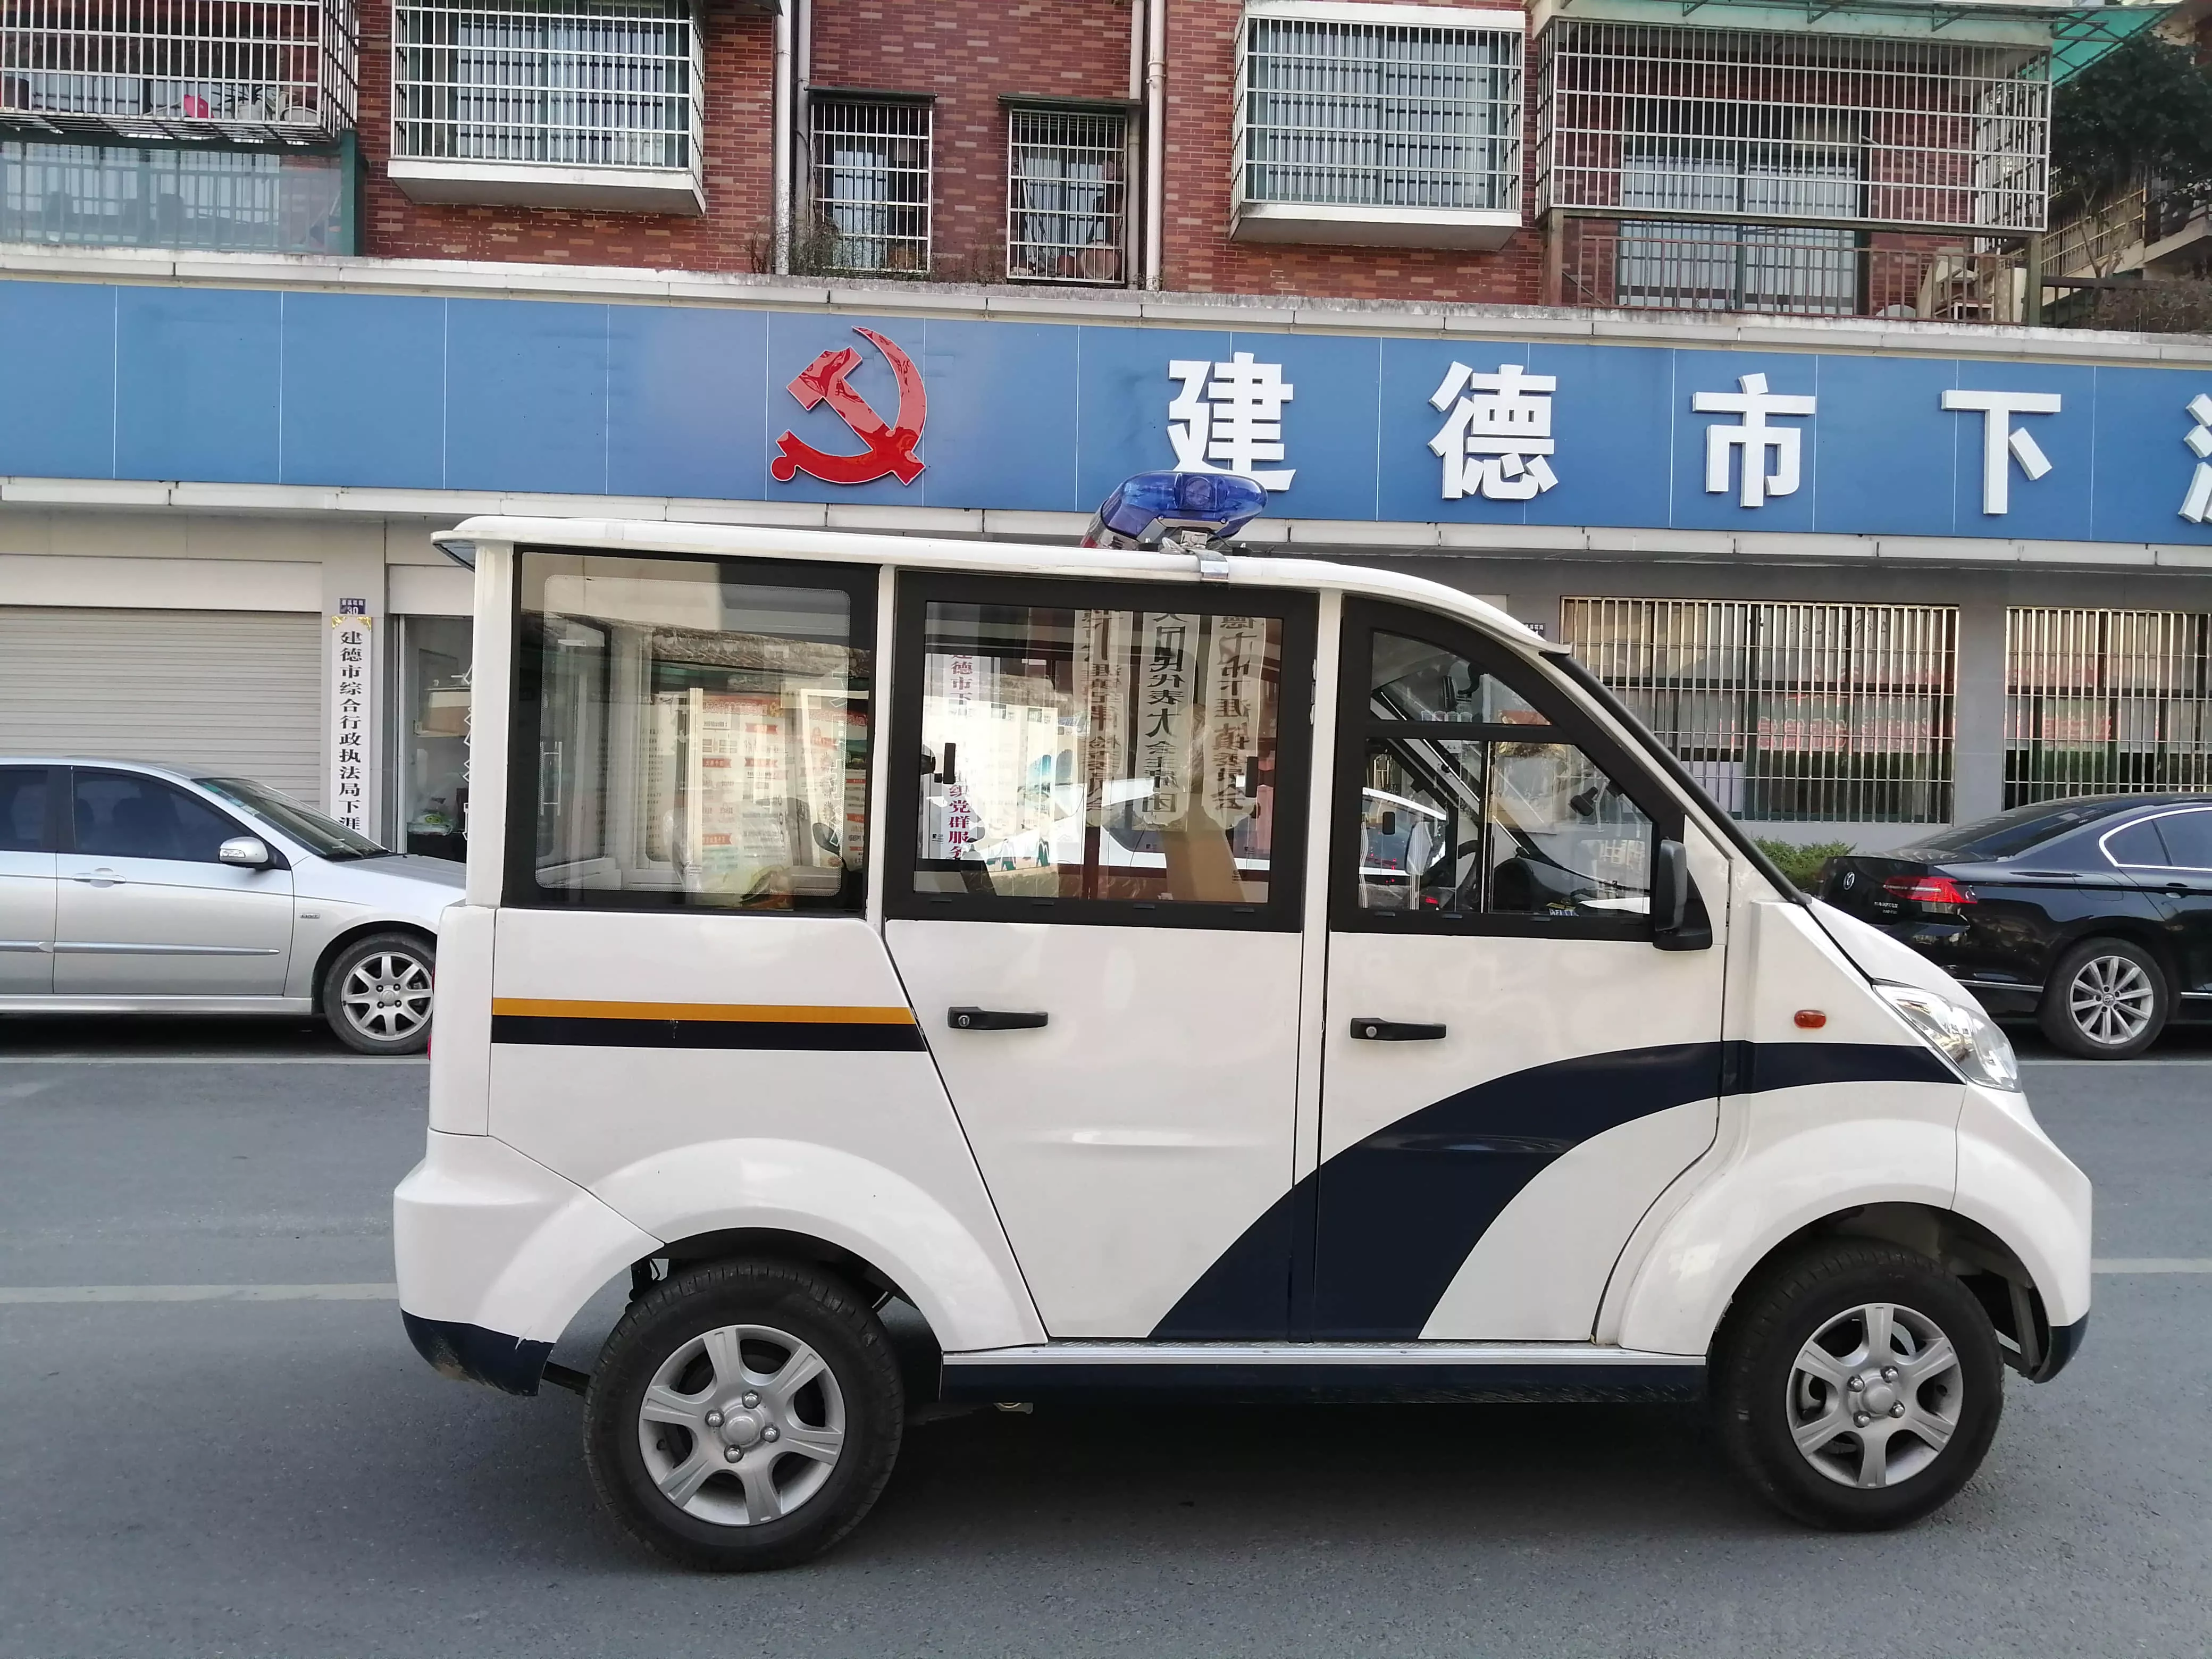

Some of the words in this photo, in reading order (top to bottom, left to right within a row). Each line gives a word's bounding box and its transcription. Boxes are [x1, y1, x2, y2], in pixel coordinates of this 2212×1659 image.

[1168, 352, 2212, 523] 建德市下
[338, 631, 363, 830] 建德市综合行政执法局下涯
